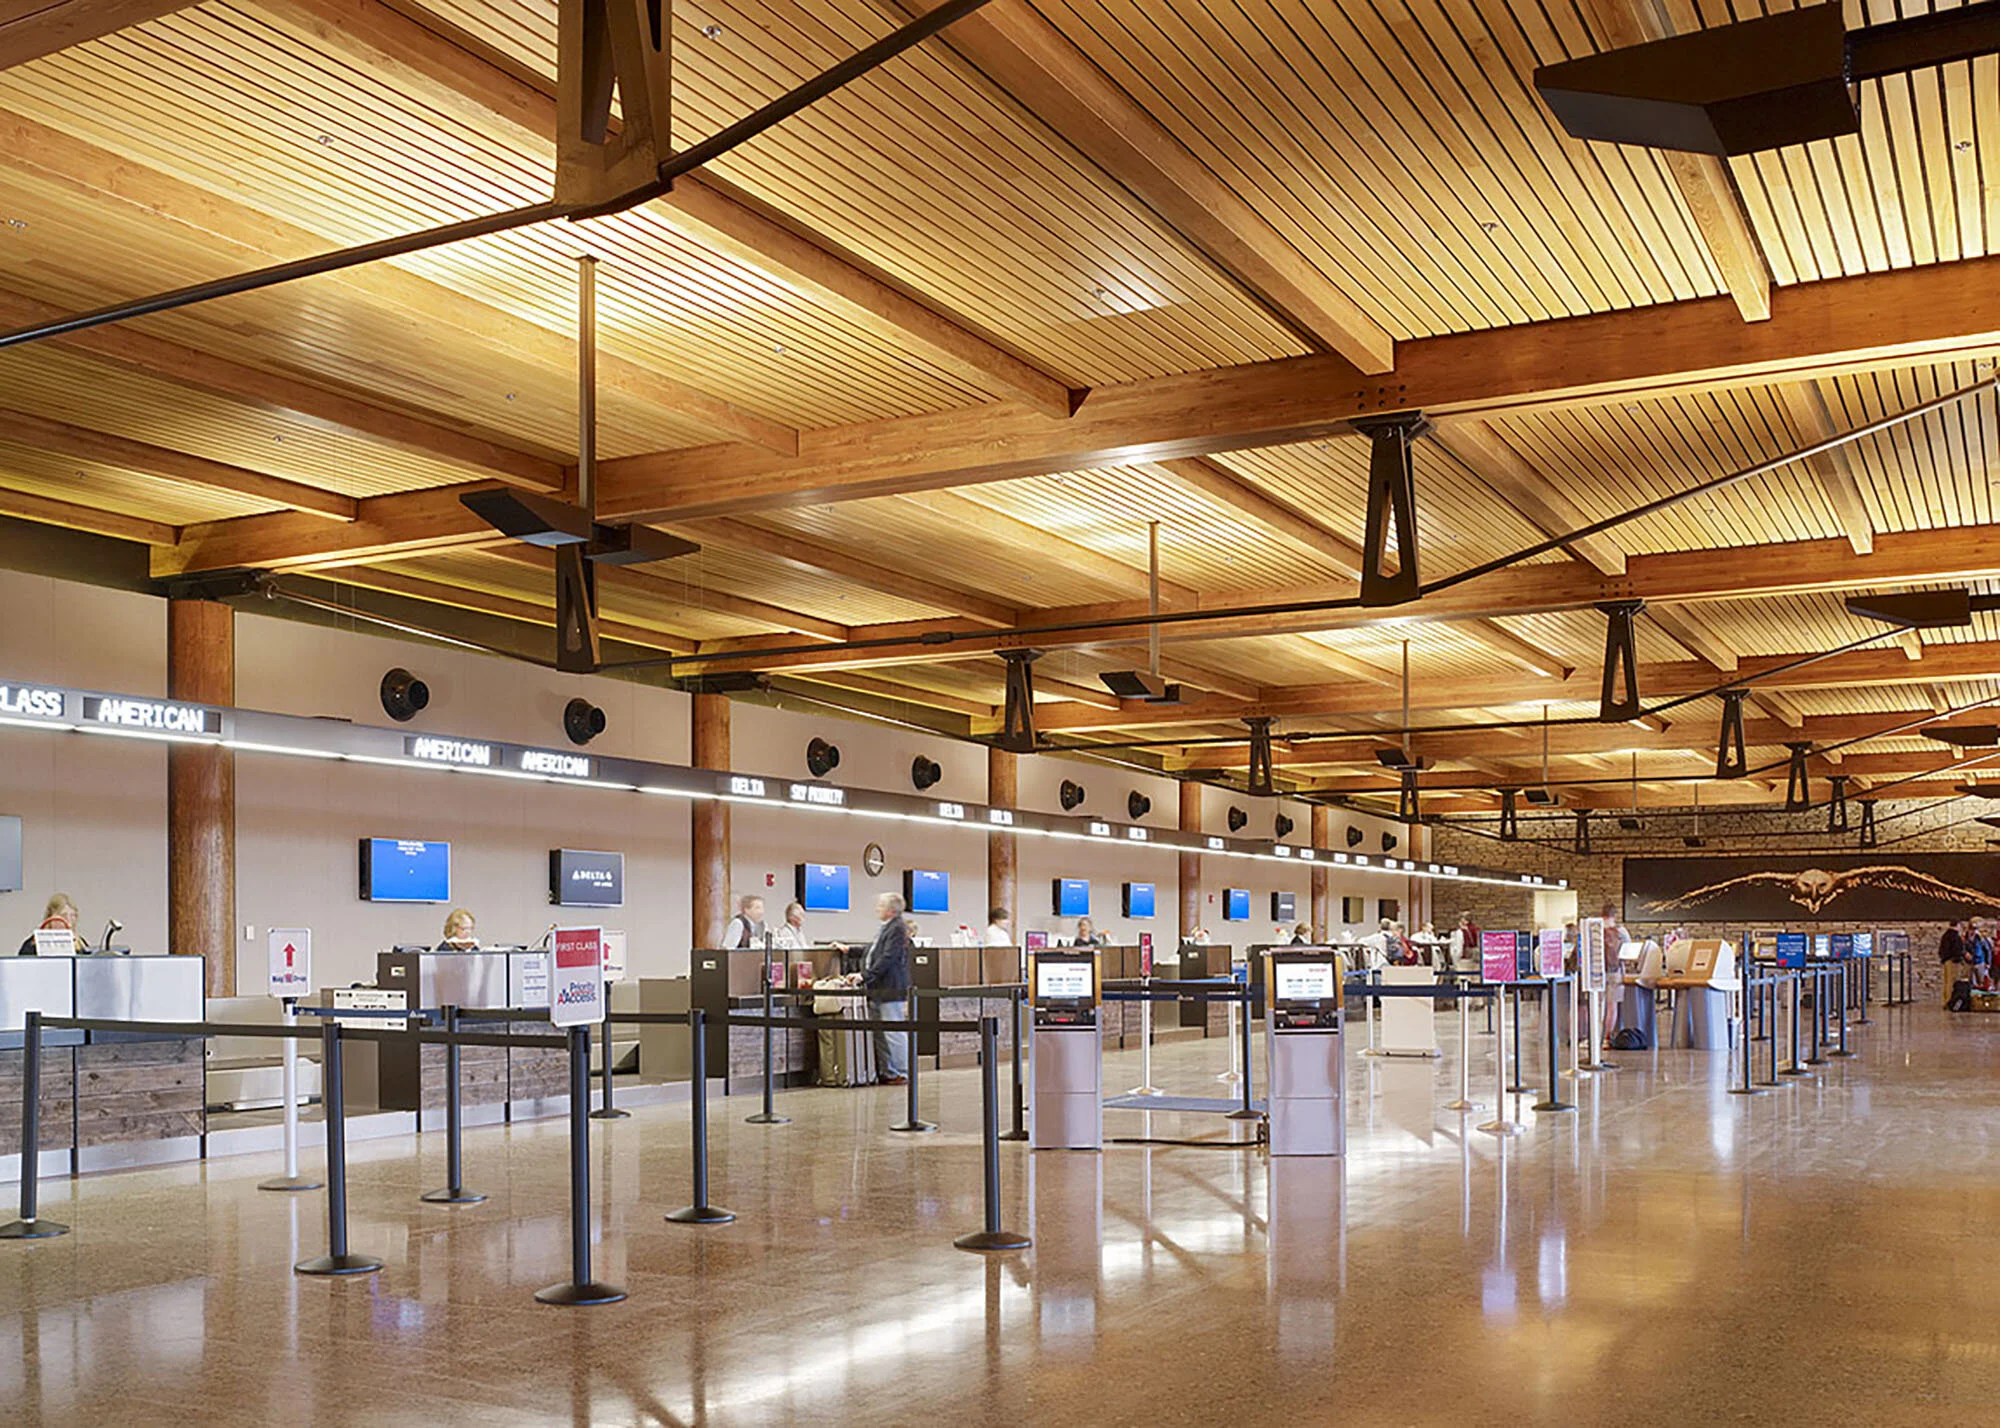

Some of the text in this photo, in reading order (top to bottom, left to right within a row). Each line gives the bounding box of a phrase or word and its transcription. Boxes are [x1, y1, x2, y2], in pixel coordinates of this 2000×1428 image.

[0, 686, 62, 715] LASS
[98, 698, 204, 732] AMERICAN
[413, 737, 490, 765] AMERICAN
[521, 751, 589, 776] AMERICAN
[556, 940, 598, 952] FIRST CLASS
